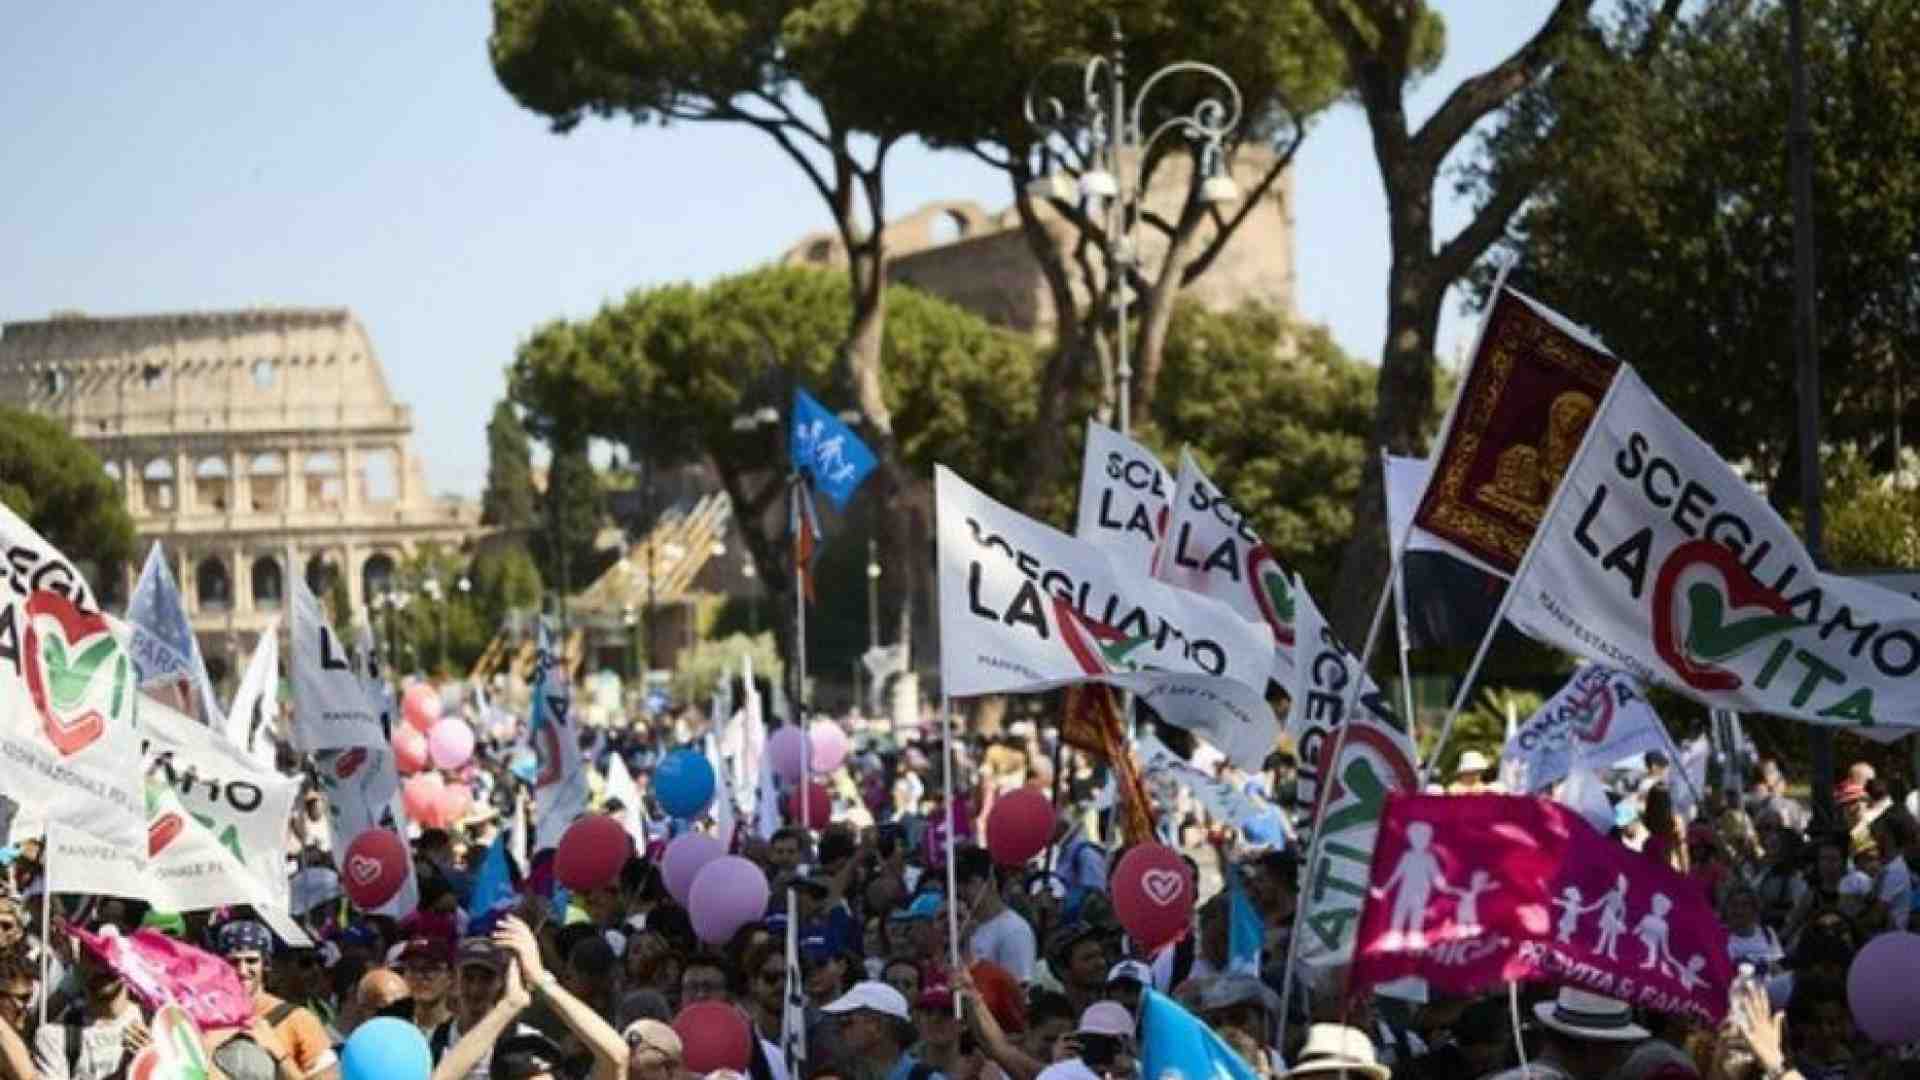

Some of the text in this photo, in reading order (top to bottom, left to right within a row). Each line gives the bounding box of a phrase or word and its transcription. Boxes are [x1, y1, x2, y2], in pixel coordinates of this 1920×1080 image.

[1099, 487, 1155, 542] LA
[1175, 521, 1240, 582] LA
[1574, 484, 1654, 599] LA
[1616, 431, 1920, 678] SCEGLIAMO
[968, 560, 1051, 640] LA
